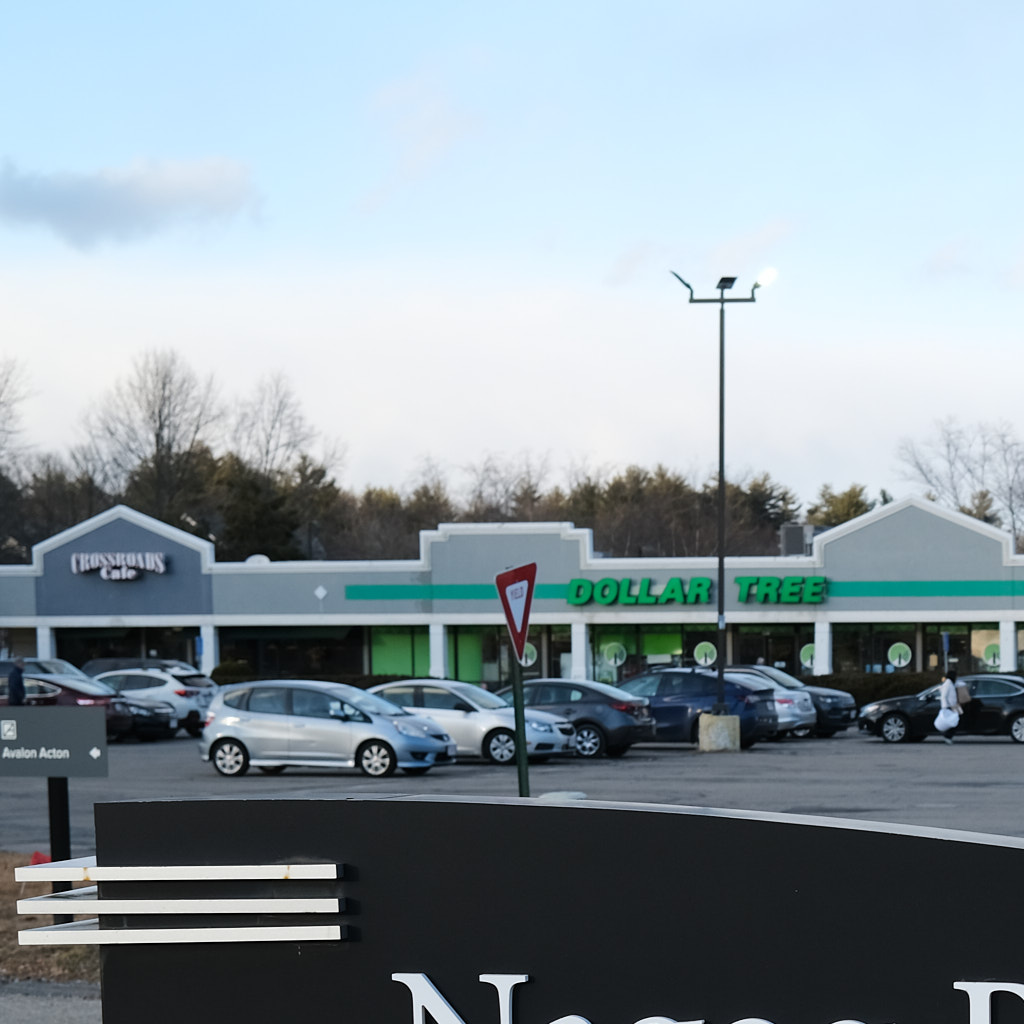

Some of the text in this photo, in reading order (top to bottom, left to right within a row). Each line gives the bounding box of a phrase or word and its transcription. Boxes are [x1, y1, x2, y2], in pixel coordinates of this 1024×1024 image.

[71, 552, 165, 574] CROSSROADS
[100, 566, 136, 580] Cafe
[566, 576, 826, 605] DOLLAR TREE
[2, 746, 70, 759] Avalon Acton
